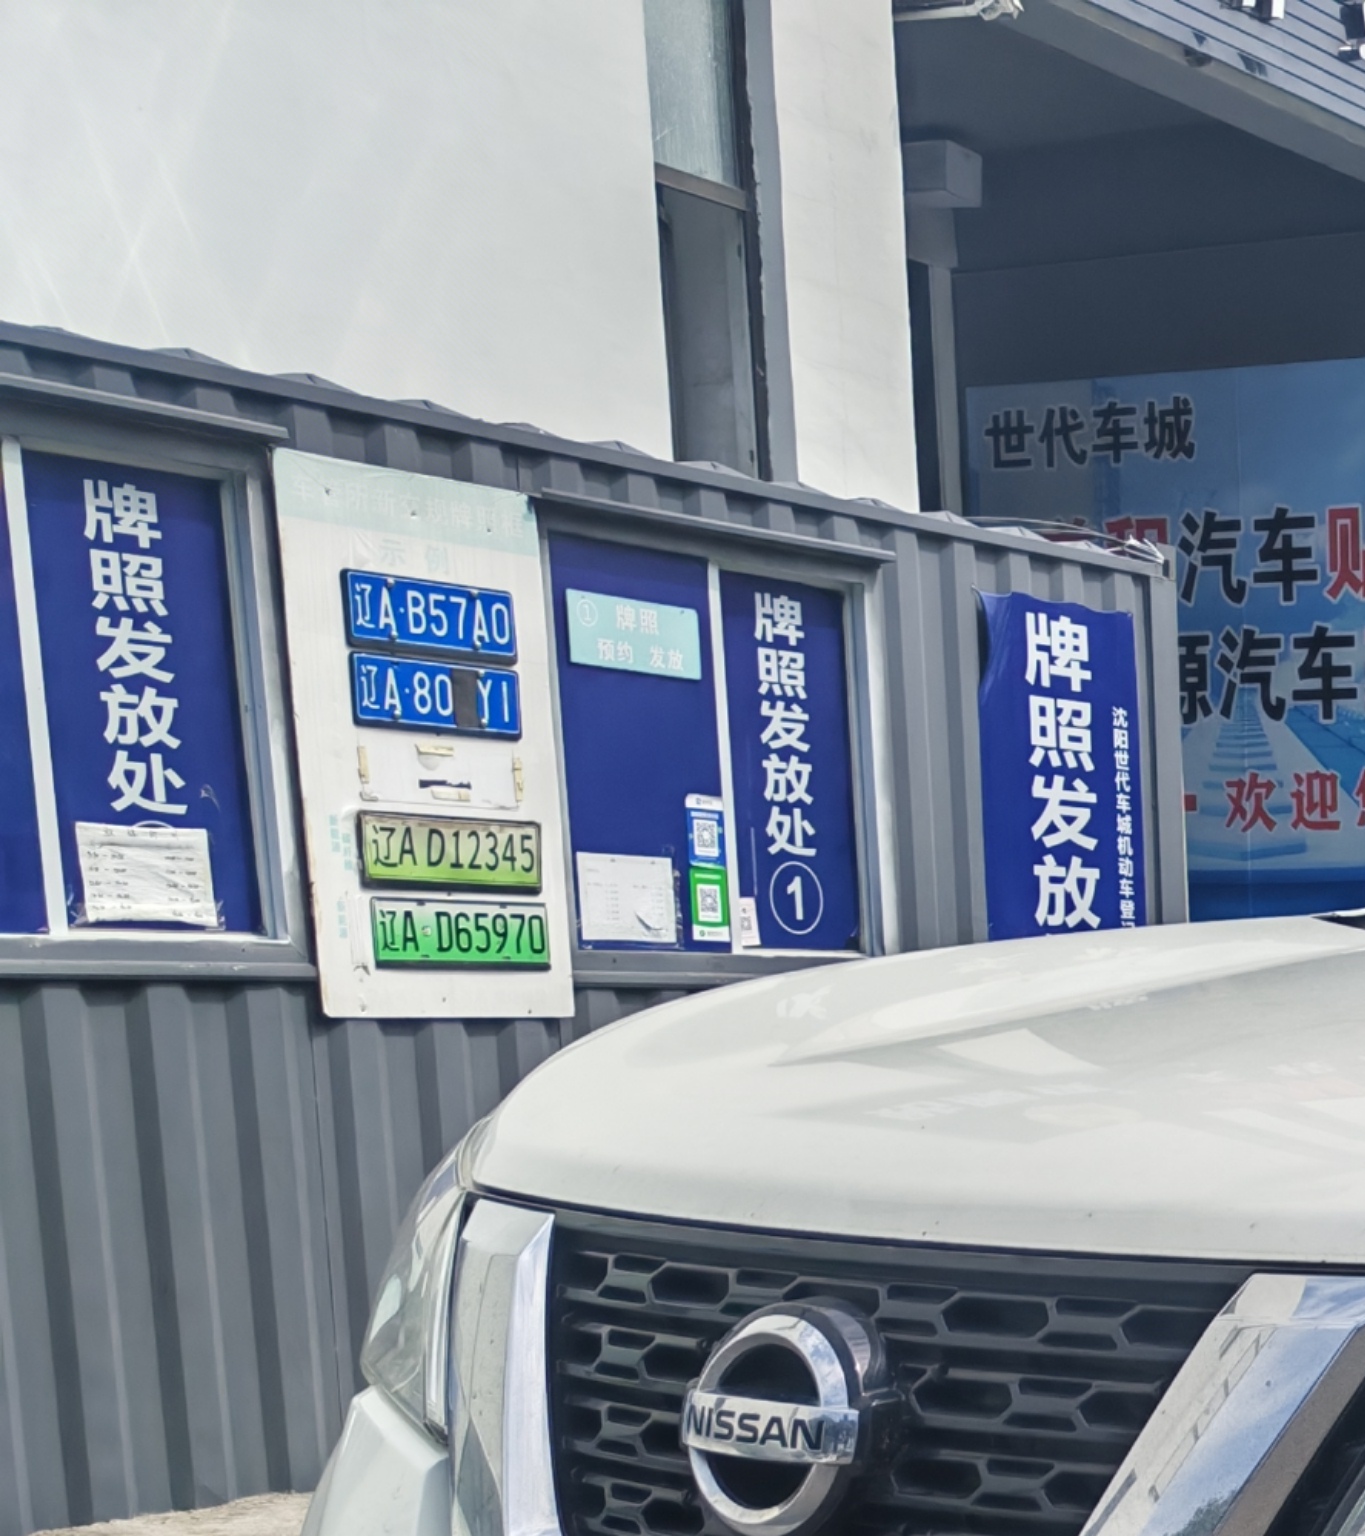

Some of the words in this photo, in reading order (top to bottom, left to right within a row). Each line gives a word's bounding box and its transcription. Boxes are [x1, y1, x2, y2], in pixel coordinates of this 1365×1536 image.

[984, 395, 1196, 468] 世代车城
[83, 478, 188, 815] 牌照发放处
[598, 637, 634, 664] 预约
[650, 645, 684, 671] 发放
[616, 604, 661, 636] 牌照
[755, 592, 817, 857] 牌照发放处
[1024, 612, 1102, 936] 牌照发放
[687, 1404, 825, 1451] NISSAN
